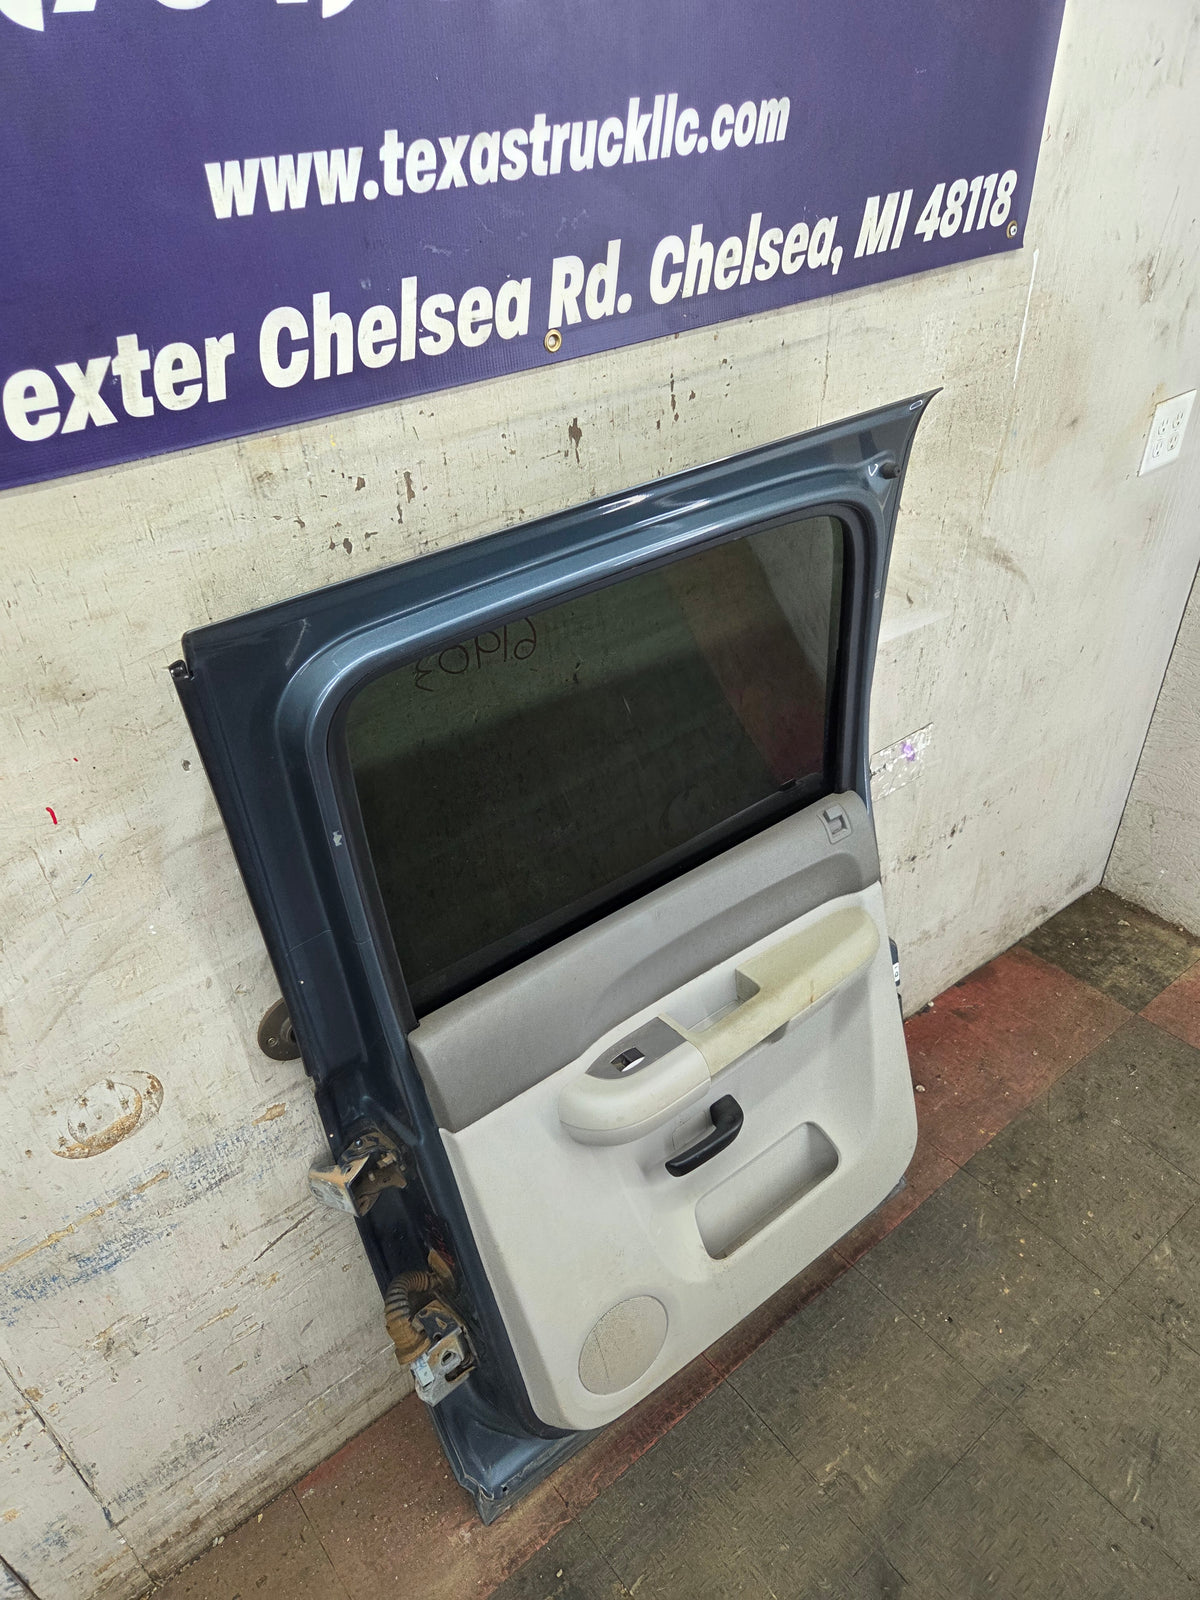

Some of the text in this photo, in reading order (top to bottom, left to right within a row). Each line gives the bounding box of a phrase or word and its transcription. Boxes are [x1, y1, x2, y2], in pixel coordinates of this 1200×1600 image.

[204, 92, 791, 220] www.texastruckllc.com
[3, 170, 1018, 441] exter Chelsea Rd. Chelsea, MI 48118
